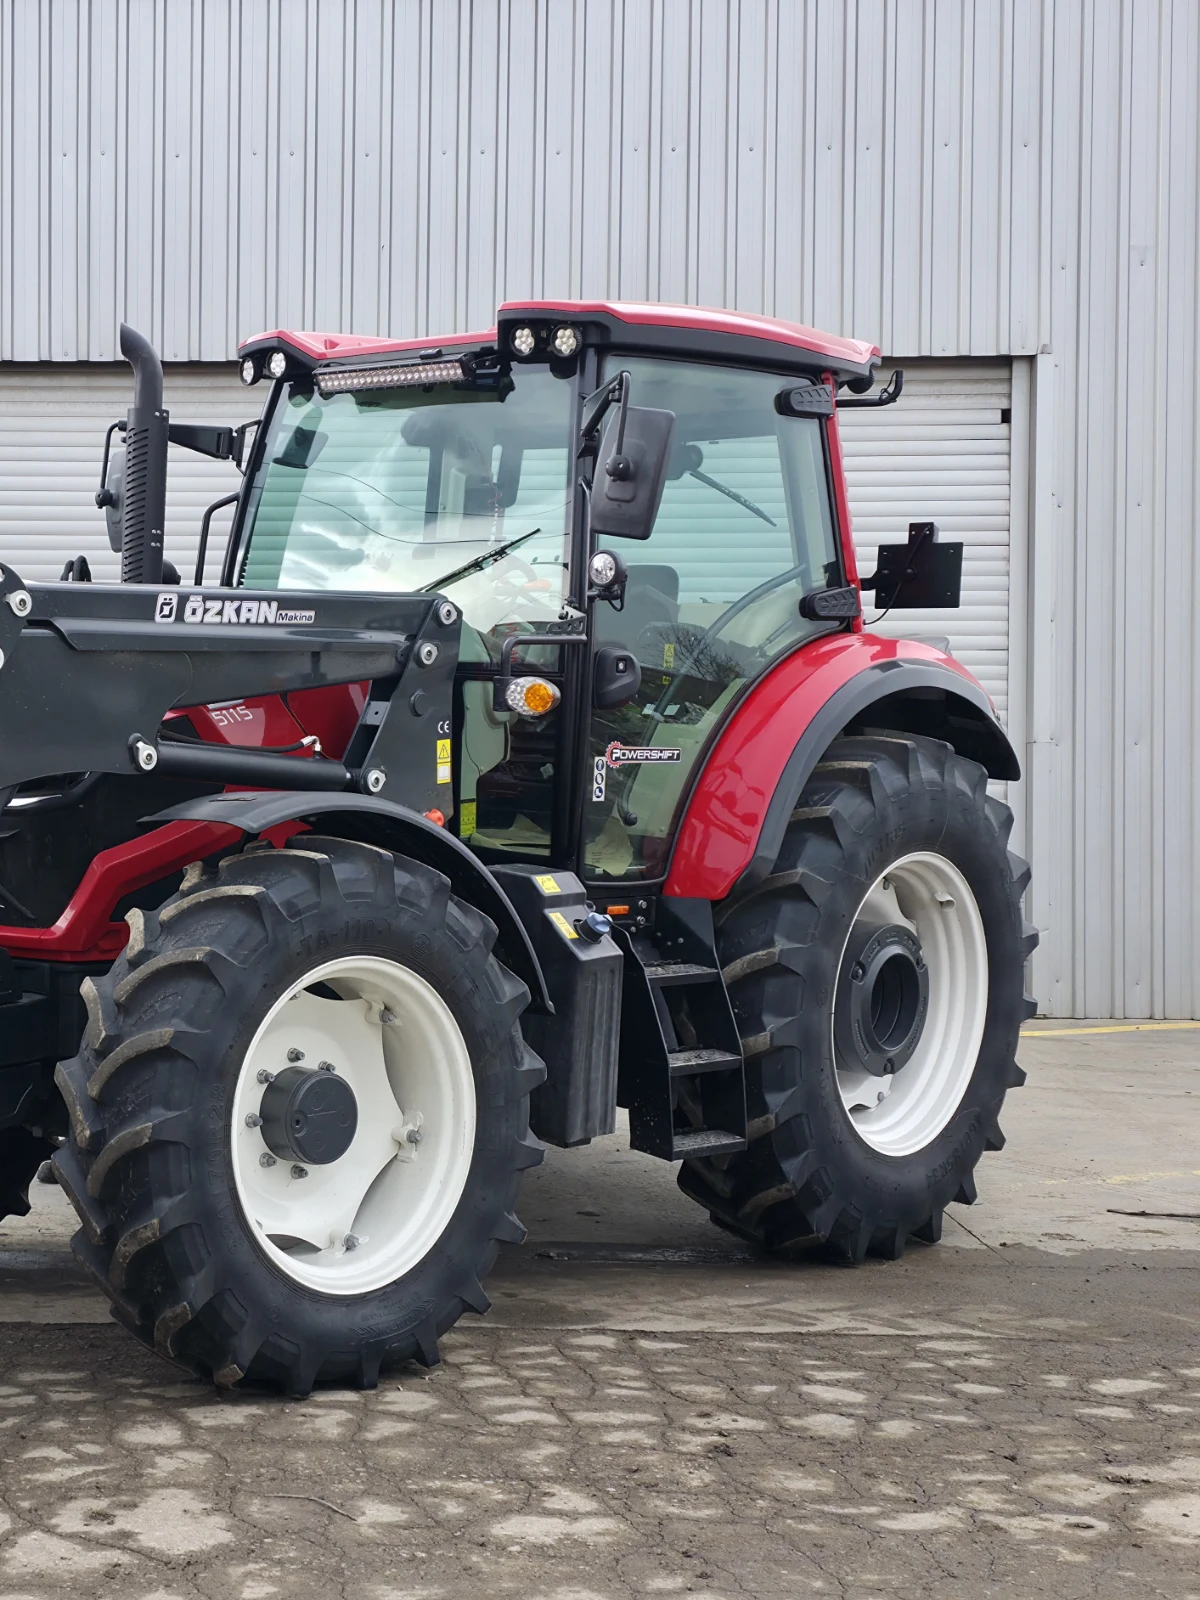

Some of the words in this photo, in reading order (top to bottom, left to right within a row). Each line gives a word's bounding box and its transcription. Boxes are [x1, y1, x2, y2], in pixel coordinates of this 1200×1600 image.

[184, 595, 278, 623] ÖZKAN
[278, 613, 313, 622] Makina
[211, 706, 253, 725] 5115
[612, 750, 680, 760] POWERSHIFT
